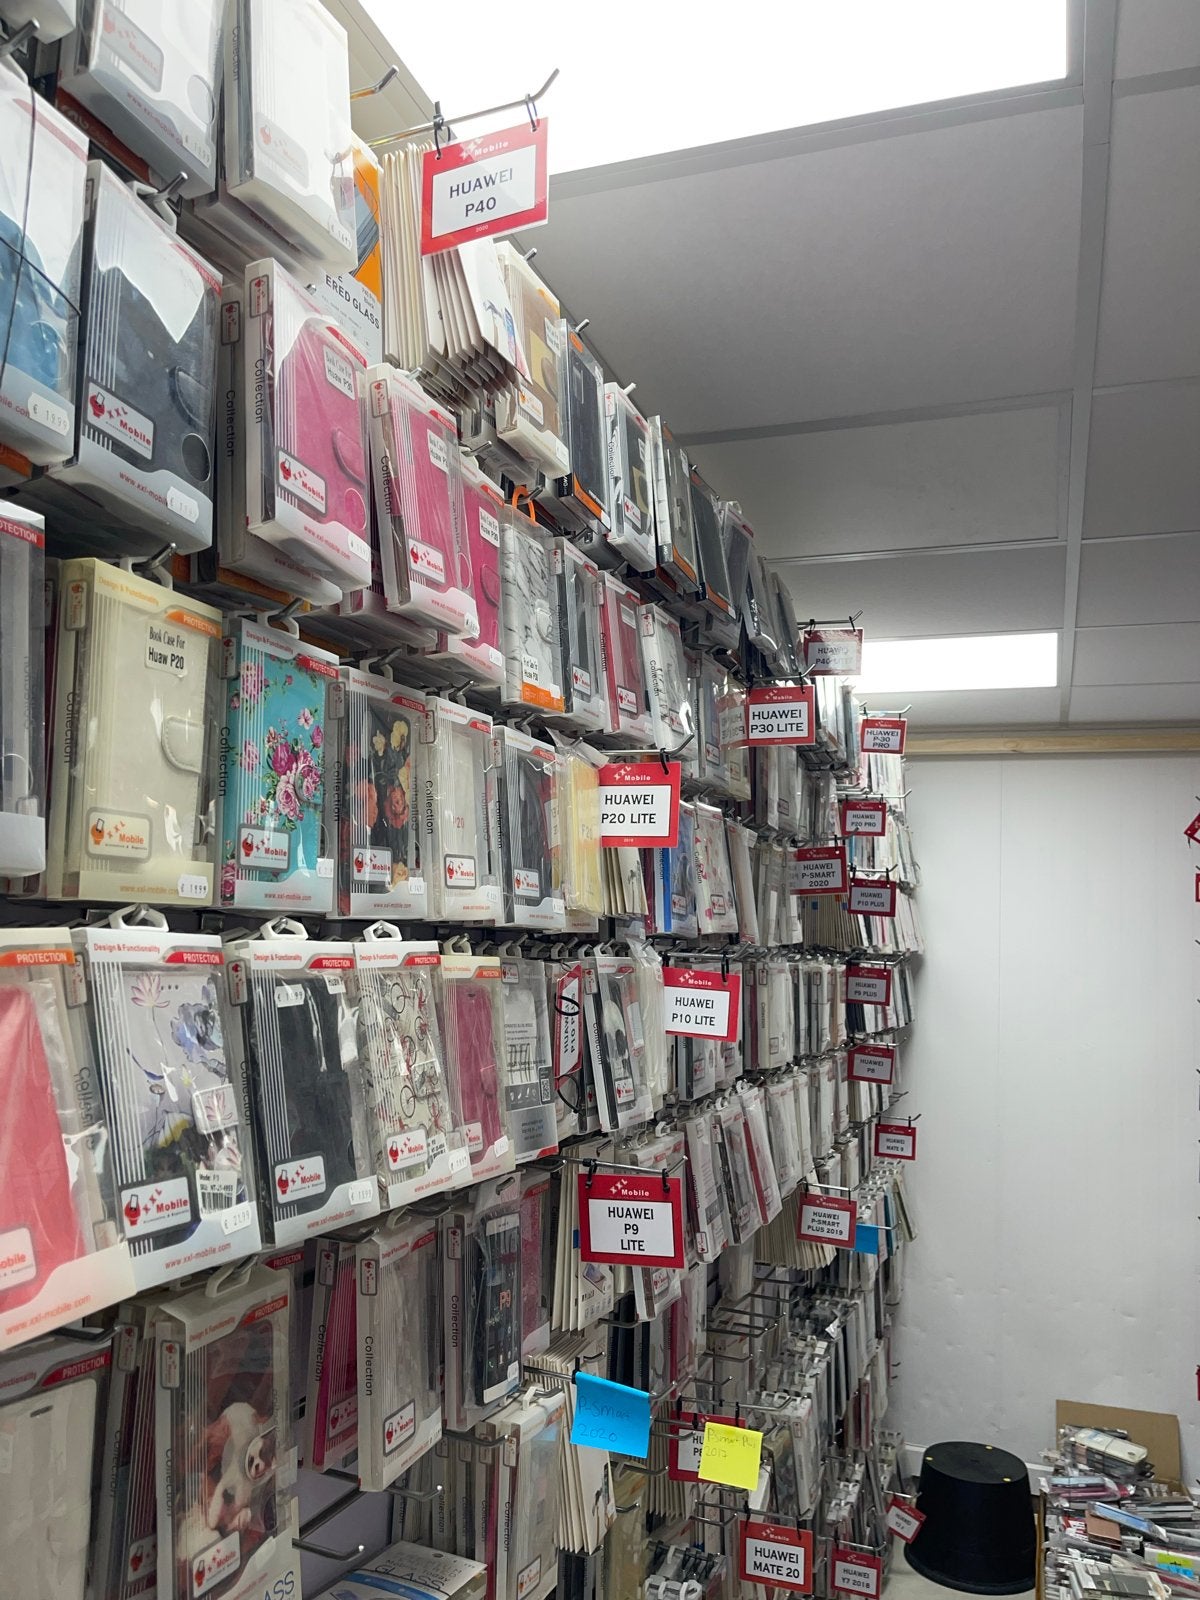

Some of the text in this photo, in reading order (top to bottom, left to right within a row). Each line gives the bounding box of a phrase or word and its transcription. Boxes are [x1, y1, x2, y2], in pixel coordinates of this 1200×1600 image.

[474, 141, 509, 157] Mobile
[449, 167, 513, 199] HUAWEI
[465, 196, 497, 218] P40
[254, 358, 265, 424] Collection
[107, 406, 128, 419] XXL
[226, 390, 236, 457] Collection
[119, 419, 152, 446] Mobile
[301, 481, 325, 502] Mobile
[381, 455, 394, 515] Collection
[149, 626, 185, 649] Book Case For
[148, 646, 184, 670] Huaw P20
[309, 660, 337, 677] PROTECTION
[752, 709, 802, 721] HUAWEI
[64, 691, 76, 764] Collection
[750, 722, 804, 734] P30 LITE
[219, 726, 230, 797] Collection
[605, 794, 654, 805] HUAWEI
[425, 780, 434, 835] Collection
[601, 813, 656, 824] P20 LITE
[119, 833, 144, 845] Mobile
[264, 850, 287, 858] Mobile
[372, 863, 391, 872] Mobile
[803, 862, 833, 871] HUAWEI
[801, 871, 836, 880] P-SMART
[860, 891, 883, 899] HUAWEI
[94, 943, 116, 953] Design
[123, 944, 160, 954] Functionality
[17, 952, 67, 964] PROTECTION
[183, 952, 219, 963] PROTECTION
[323, 959, 350, 967] PROTECTION
[415, 956, 438, 964] PROTECTION
[688, 978, 712, 986] Mobile
[855, 981, 877, 989] HUAWEI
[674, 996, 715, 1010] HUAWEI
[671, 1012, 716, 1027] P10 LITE
[860, 1058, 884, 1067] HUAWEI
[407, 1144, 424, 1155] Mobile
[301, 1173, 322, 1185] Mobile
[609, 1178, 628, 1195] XXL
[621, 1188, 650, 1197] Mobile
[156, 1199, 189, 1214] Mobile
[607, 1206, 655, 1221] HUAWEI
[812, 1211, 840, 1220] HUAWEI
[624, 1223, 640, 1235] P9
[810, 1218, 841, 1228] P-SMART
[807, 1225, 843, 1236] PLUS 2019
[620, 1239, 646, 1252] LITE
[451, 1295, 459, 1348] Collection
[62, 1357, 106, 1379] PROTECTION
[365, 1335, 373, 1397] Collection
[578, 1423, 618, 1443] 2020
[754, 1546, 799, 1564] HUAWEI
[753, 1561, 800, 1579] MATE 20
[843, 1567, 870, 1578] HUAWEI
[375, 1565, 445, 1590] GLASS
[852, 1579, 871, 1589] 2018
